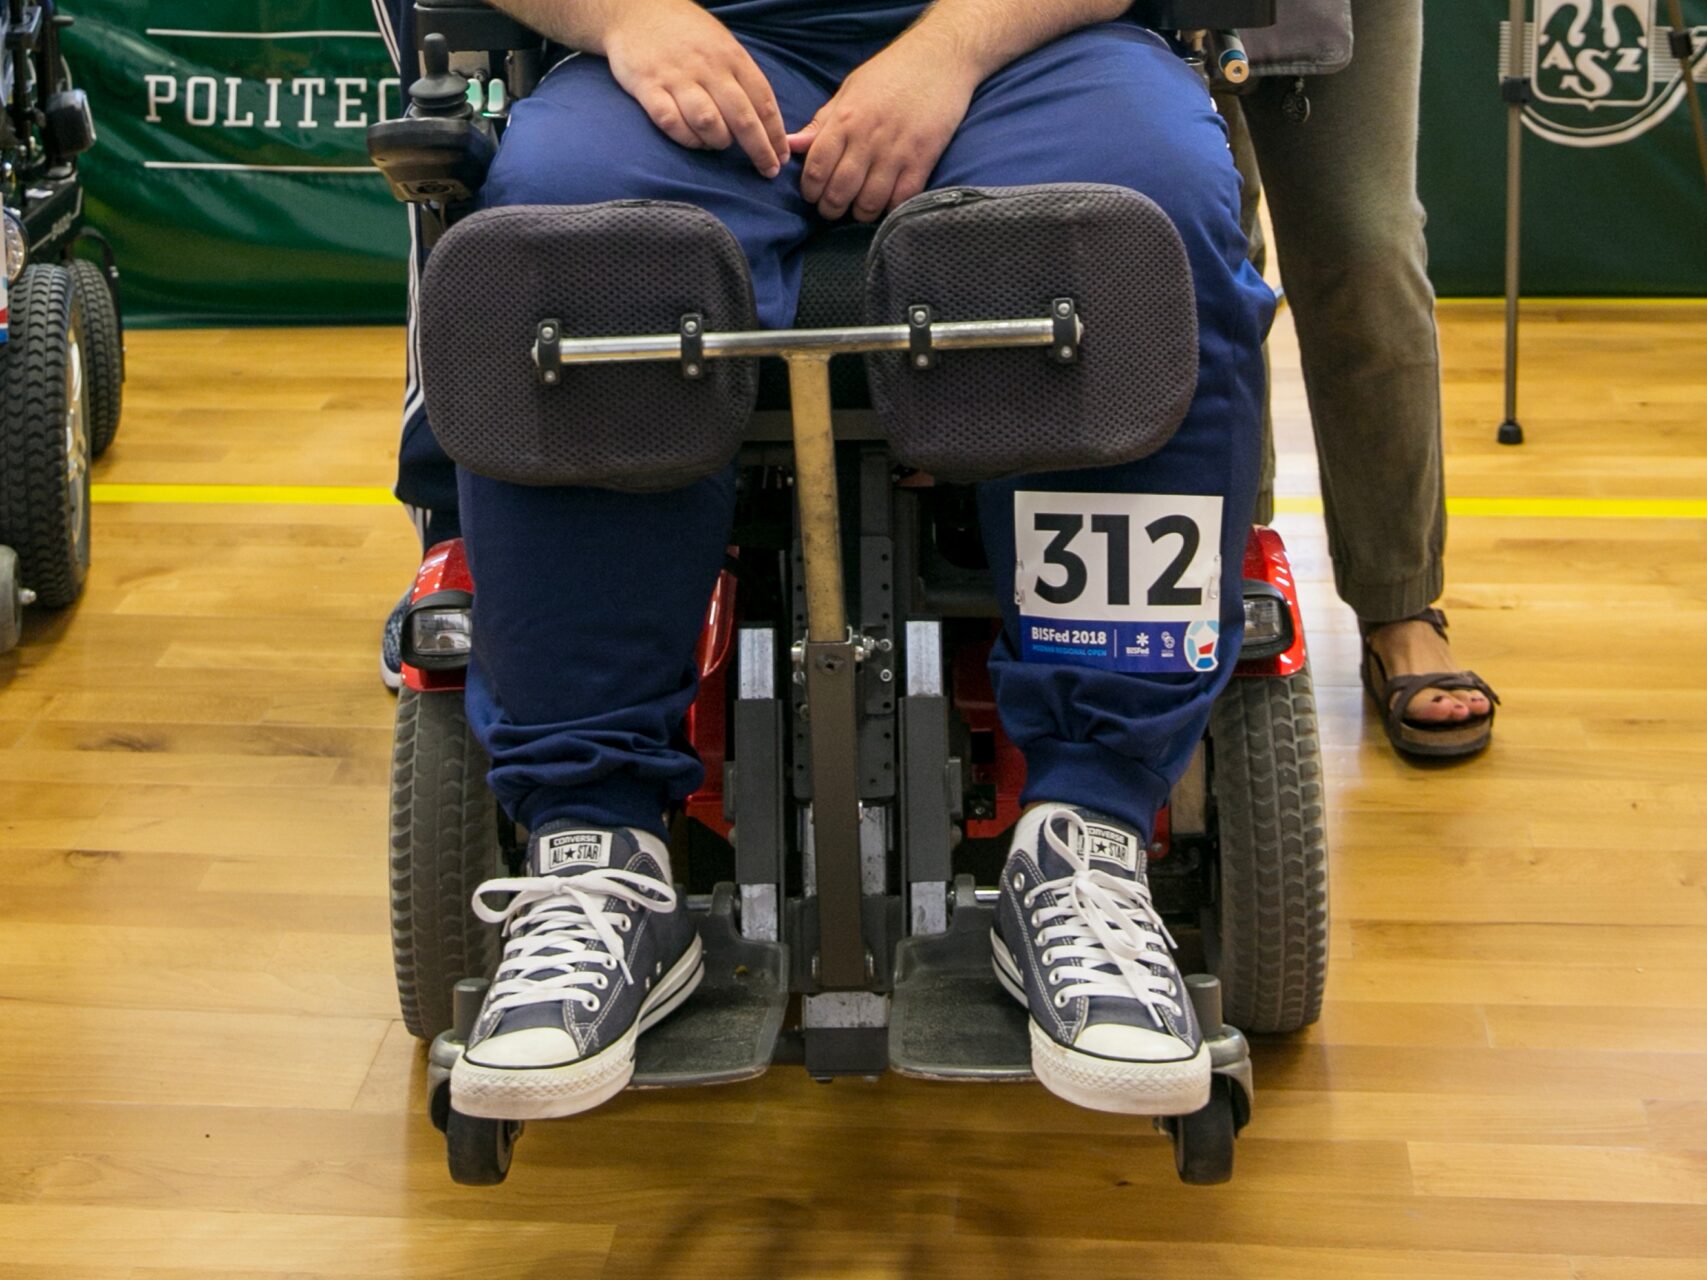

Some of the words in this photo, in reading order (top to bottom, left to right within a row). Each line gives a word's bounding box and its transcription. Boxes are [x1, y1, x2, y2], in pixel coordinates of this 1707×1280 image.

[1034, 513, 1203, 607] 312
[1031, 626, 1070, 643] BISFed
[1072, 630, 1108, 645] 2018
[552, 834, 598, 846] CONVERSE
[1087, 827, 1126, 844] ONVERSE
[552, 847, 564, 865] ALL
[577, 844, 600, 860] STAR
